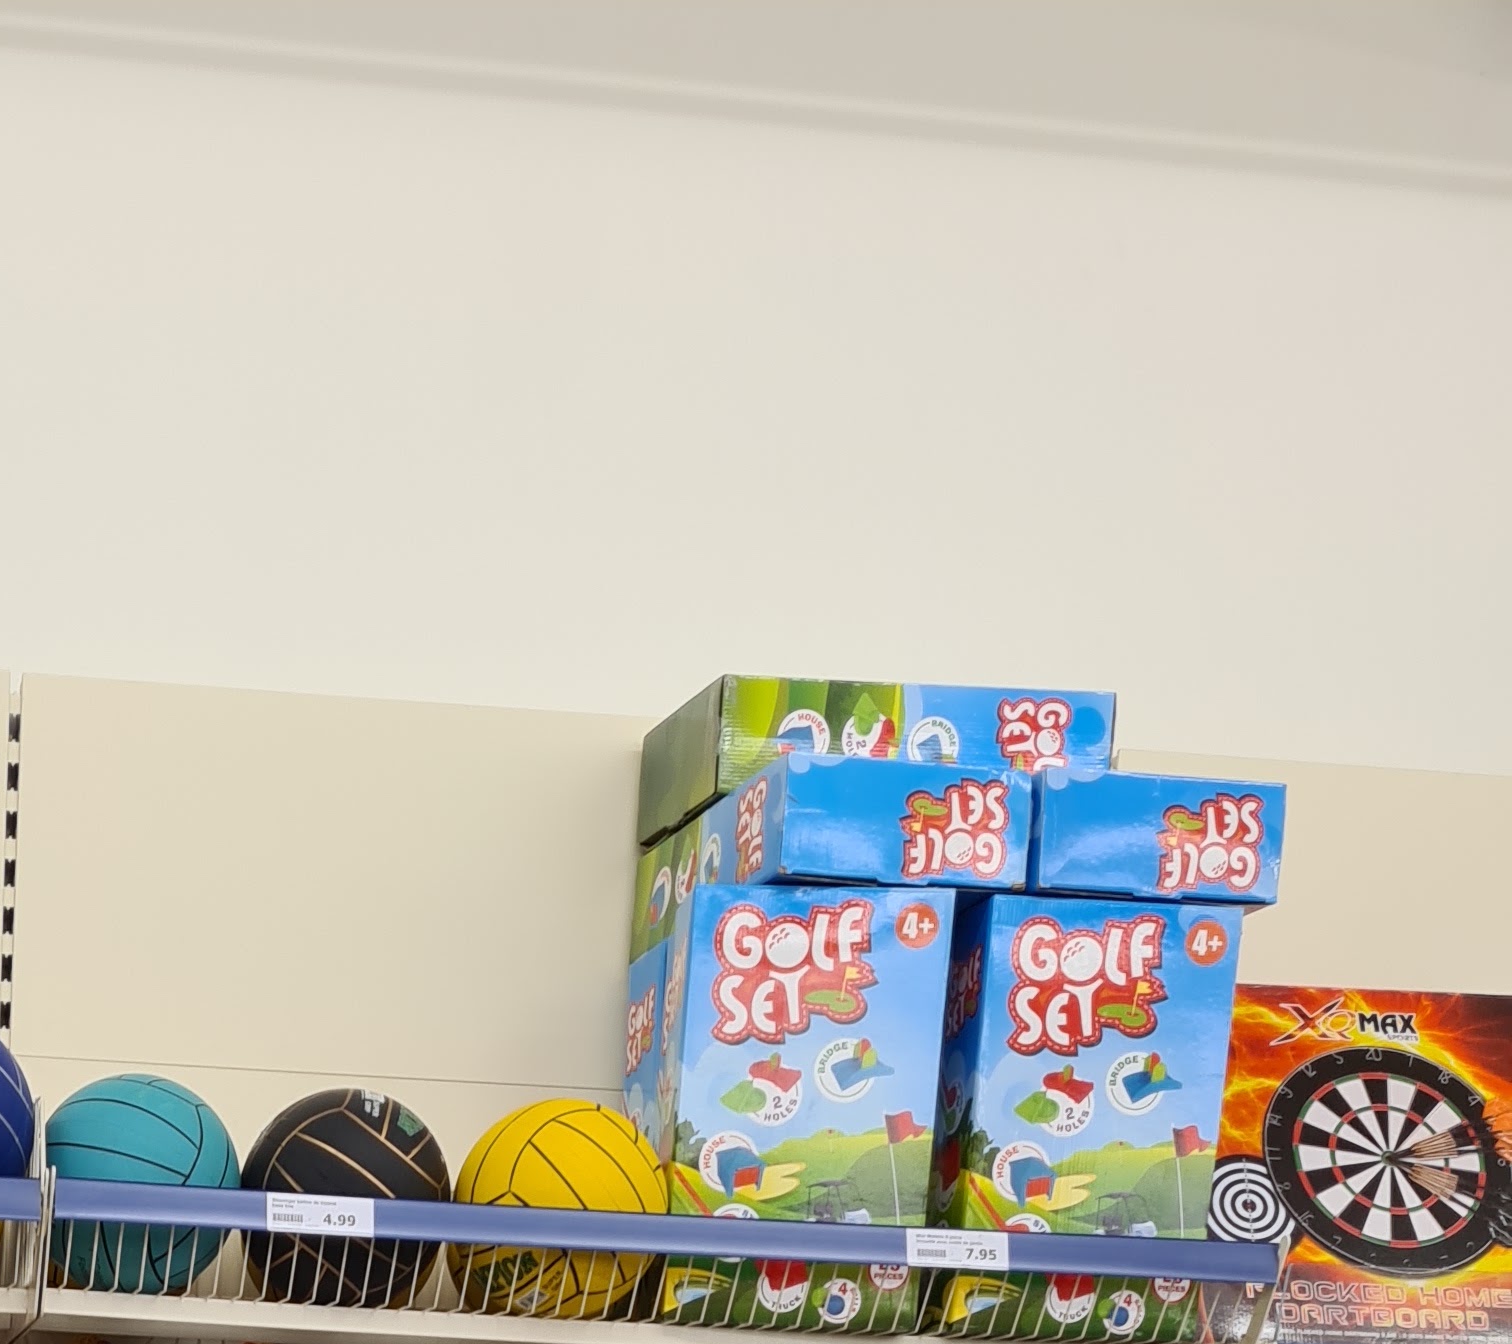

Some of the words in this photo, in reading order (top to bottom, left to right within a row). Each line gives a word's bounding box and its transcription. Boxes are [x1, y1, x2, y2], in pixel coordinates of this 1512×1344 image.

[946, 786, 1005, 834] SET
[1200, 799, 1260, 849] SET
[908, 830, 1004, 875] GOLF
[1163, 844, 1256, 889] GOLF
[721, 904, 868, 970] GOLF
[901, 915, 935, 938] 4+
[1018, 918, 1157, 985] GOLF
[1191, 930, 1223, 957] 4+
[719, 967, 808, 1035] SET
[1016, 978, 1097, 1045] SET
[1357, 1012, 1417, 1035] MAX
[817, 1041, 849, 1077] BRIDGE
[1109, 1054, 1140, 1087] BRIDGE
[764, 1097, 798, 1124] HOLES
[772, 1096, 782, 1110] 2
[1065, 1108, 1075, 1120] 2
[1056, 1110, 1090, 1134] HOLES
[702, 1134, 728, 1171] HOUSE
[996, 1145, 1020, 1179] HOUSE
[323, 1213, 355, 1226] 4.99
[965, 1248, 997, 1261] 7.95
[1417, 1286, 1512, 1309] HOME
[1276, 1302, 1490, 1330] DARTBOARD
